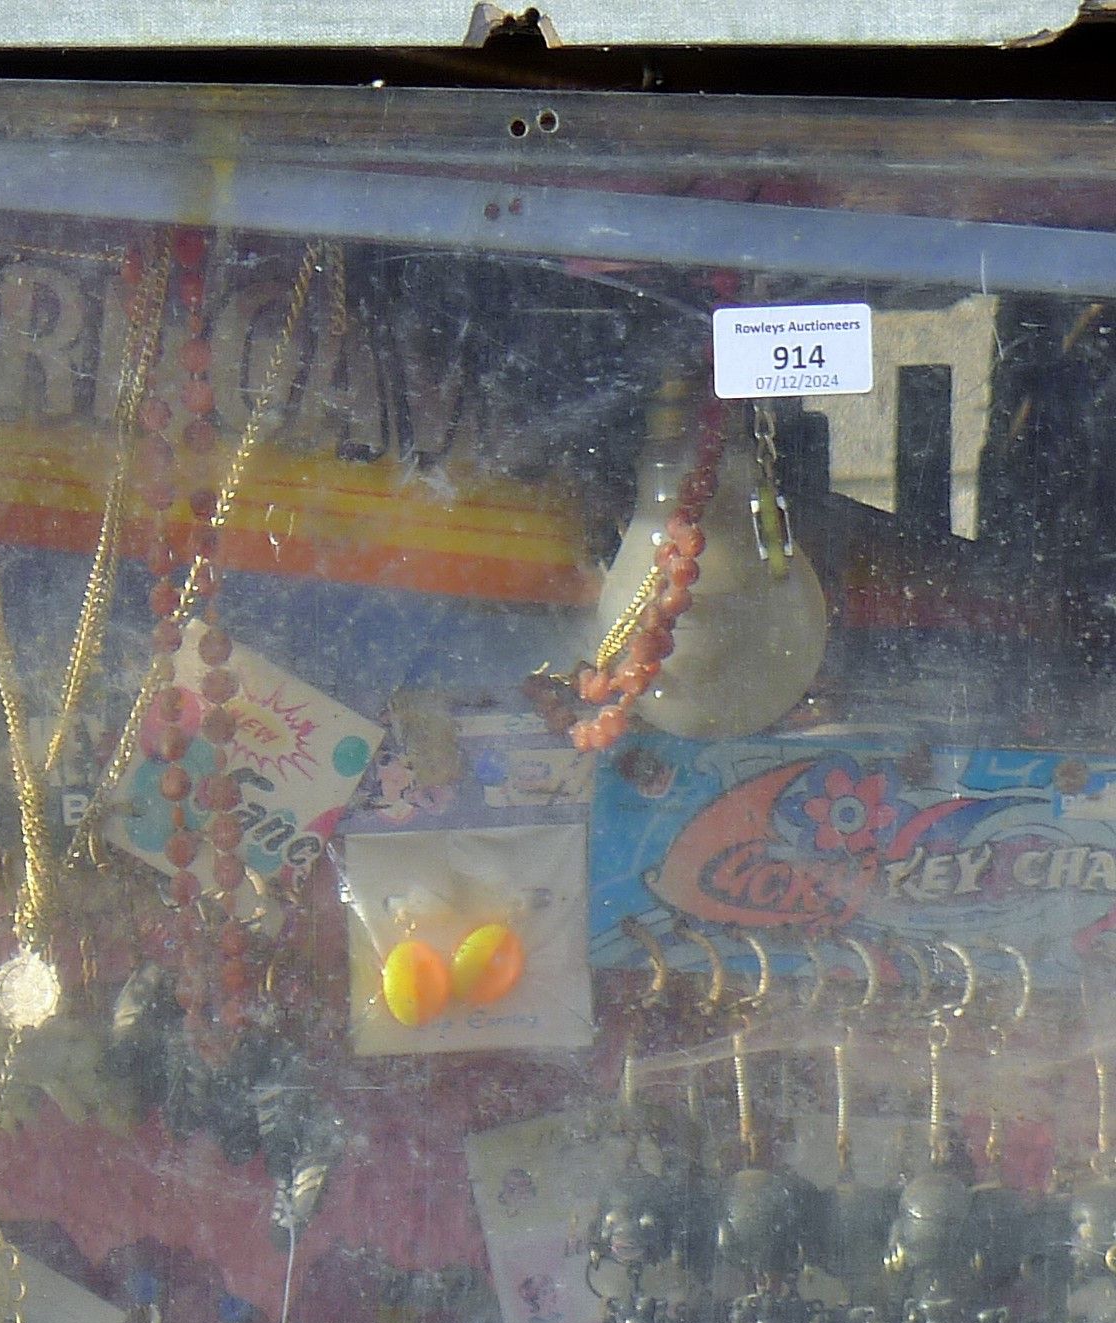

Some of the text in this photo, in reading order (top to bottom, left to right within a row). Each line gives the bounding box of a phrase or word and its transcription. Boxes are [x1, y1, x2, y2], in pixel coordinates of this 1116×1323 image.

[735, 319, 861, 335] Rowleys Auctioneers
[773, 345, 826, 370] 914
[755, 374, 839, 392] 07/12/2024
[885, 845, 992, 900] KEY
